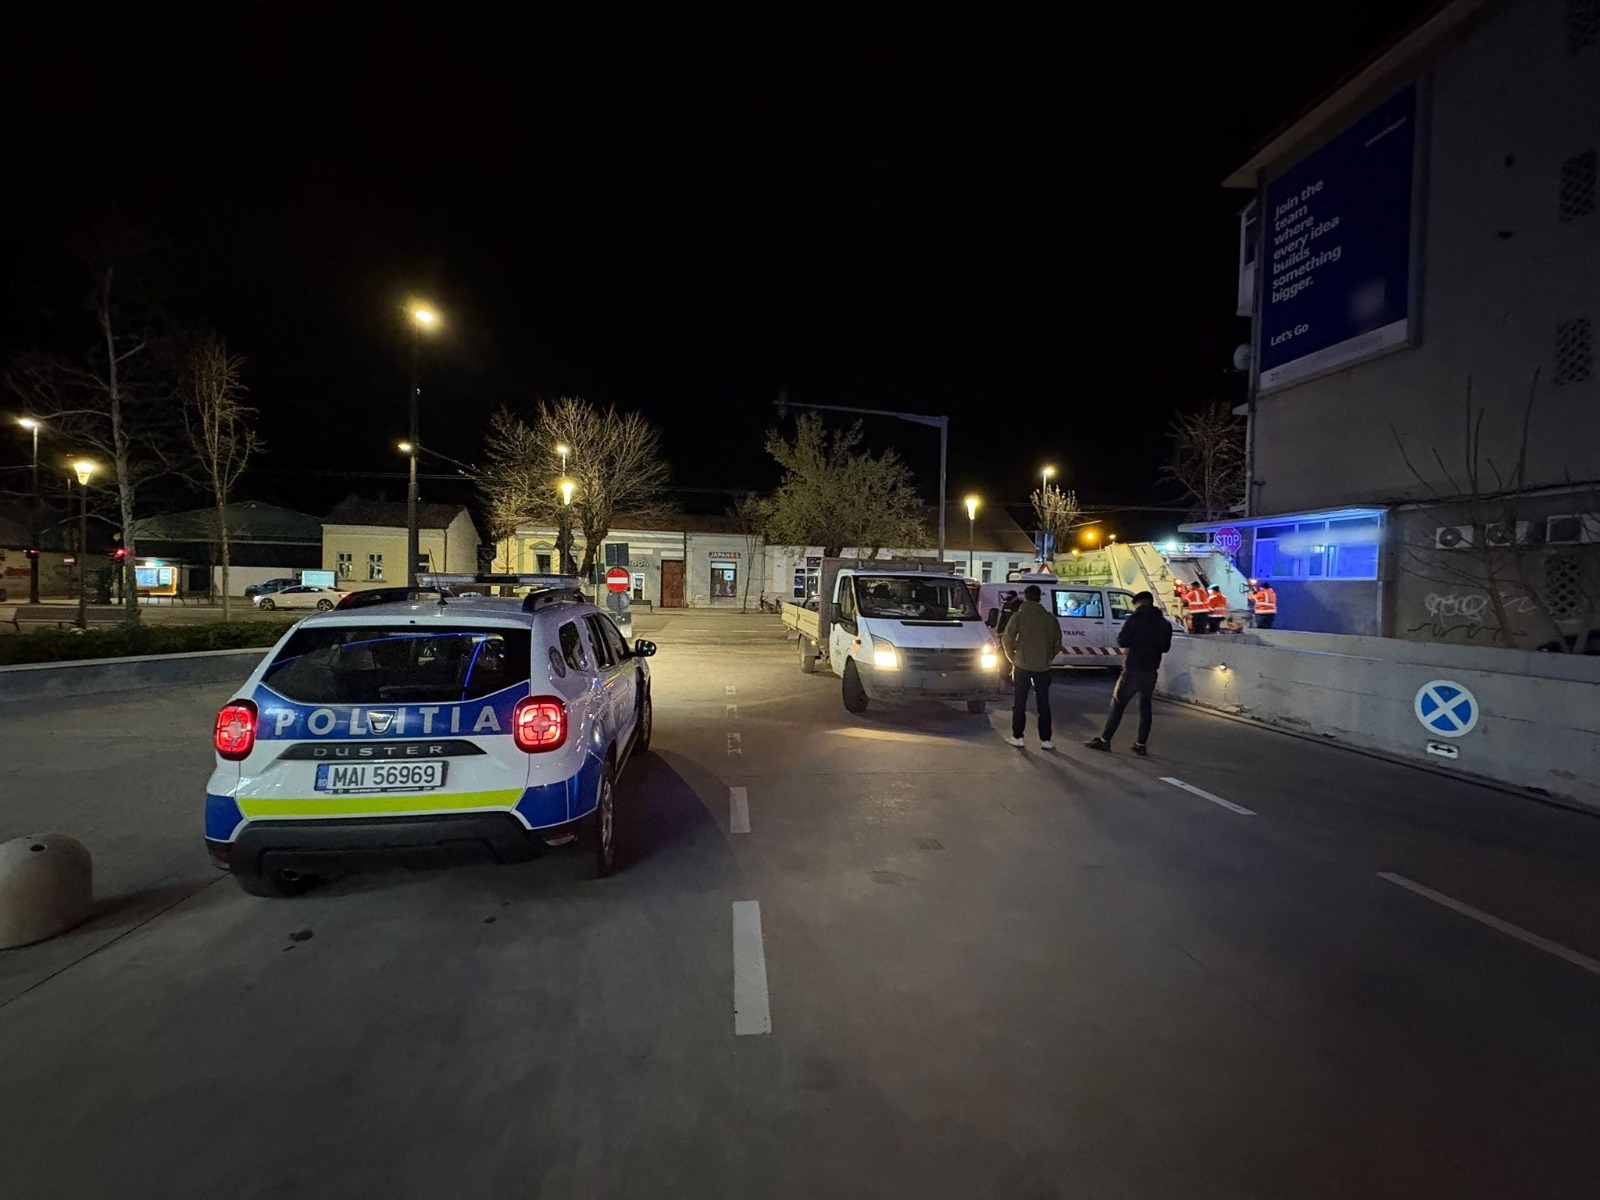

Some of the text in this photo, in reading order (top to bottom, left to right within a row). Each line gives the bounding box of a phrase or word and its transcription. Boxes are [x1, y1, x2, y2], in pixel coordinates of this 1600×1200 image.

[1274, 180, 1324, 221] Join the
[1274, 216, 1314, 246] where
[1275, 205, 1308, 231] team
[1273, 216, 1340, 260] every idea
[1272, 245, 1342, 290] something
[1273, 247, 1310, 275] builds
[1271, 276, 1314, 304] bigger.
[1270, 323, 1309, 347] Let's Go
[1215, 534, 1240, 547] STOP
[274, 705, 501, 737] POLITIA
[313, 745, 443, 757] DUSTER
[332, 764, 436, 788] MAI 56969
